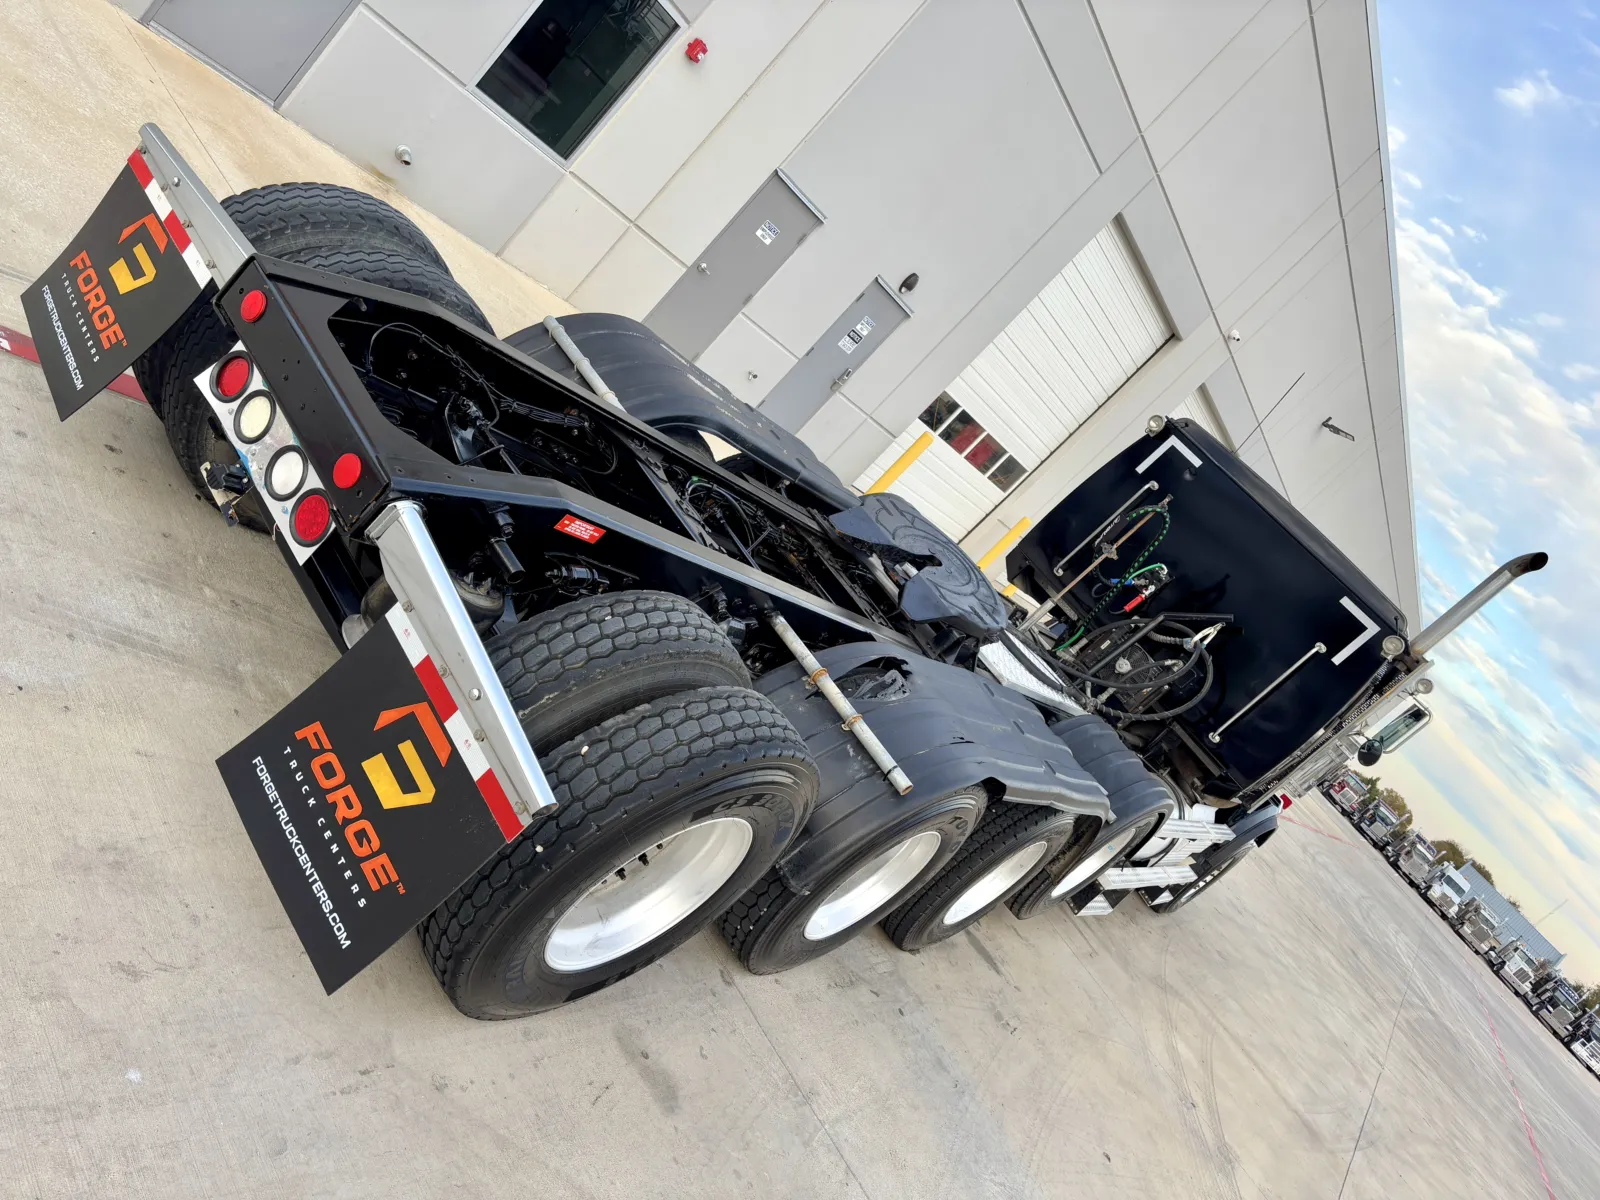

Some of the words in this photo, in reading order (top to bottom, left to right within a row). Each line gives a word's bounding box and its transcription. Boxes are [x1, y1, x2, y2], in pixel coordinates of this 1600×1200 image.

[42, 285, 84, 391] FORGETRUCKCENTERS.COM
[61, 272, 77, 307] TRUCK
[75, 311, 100, 363] CENTERS
[252, 756, 352, 950] FORGETRUCKCENTERS.COM
[284, 746, 317, 808] TRUCK
[318, 818, 367, 908] CENTERS
